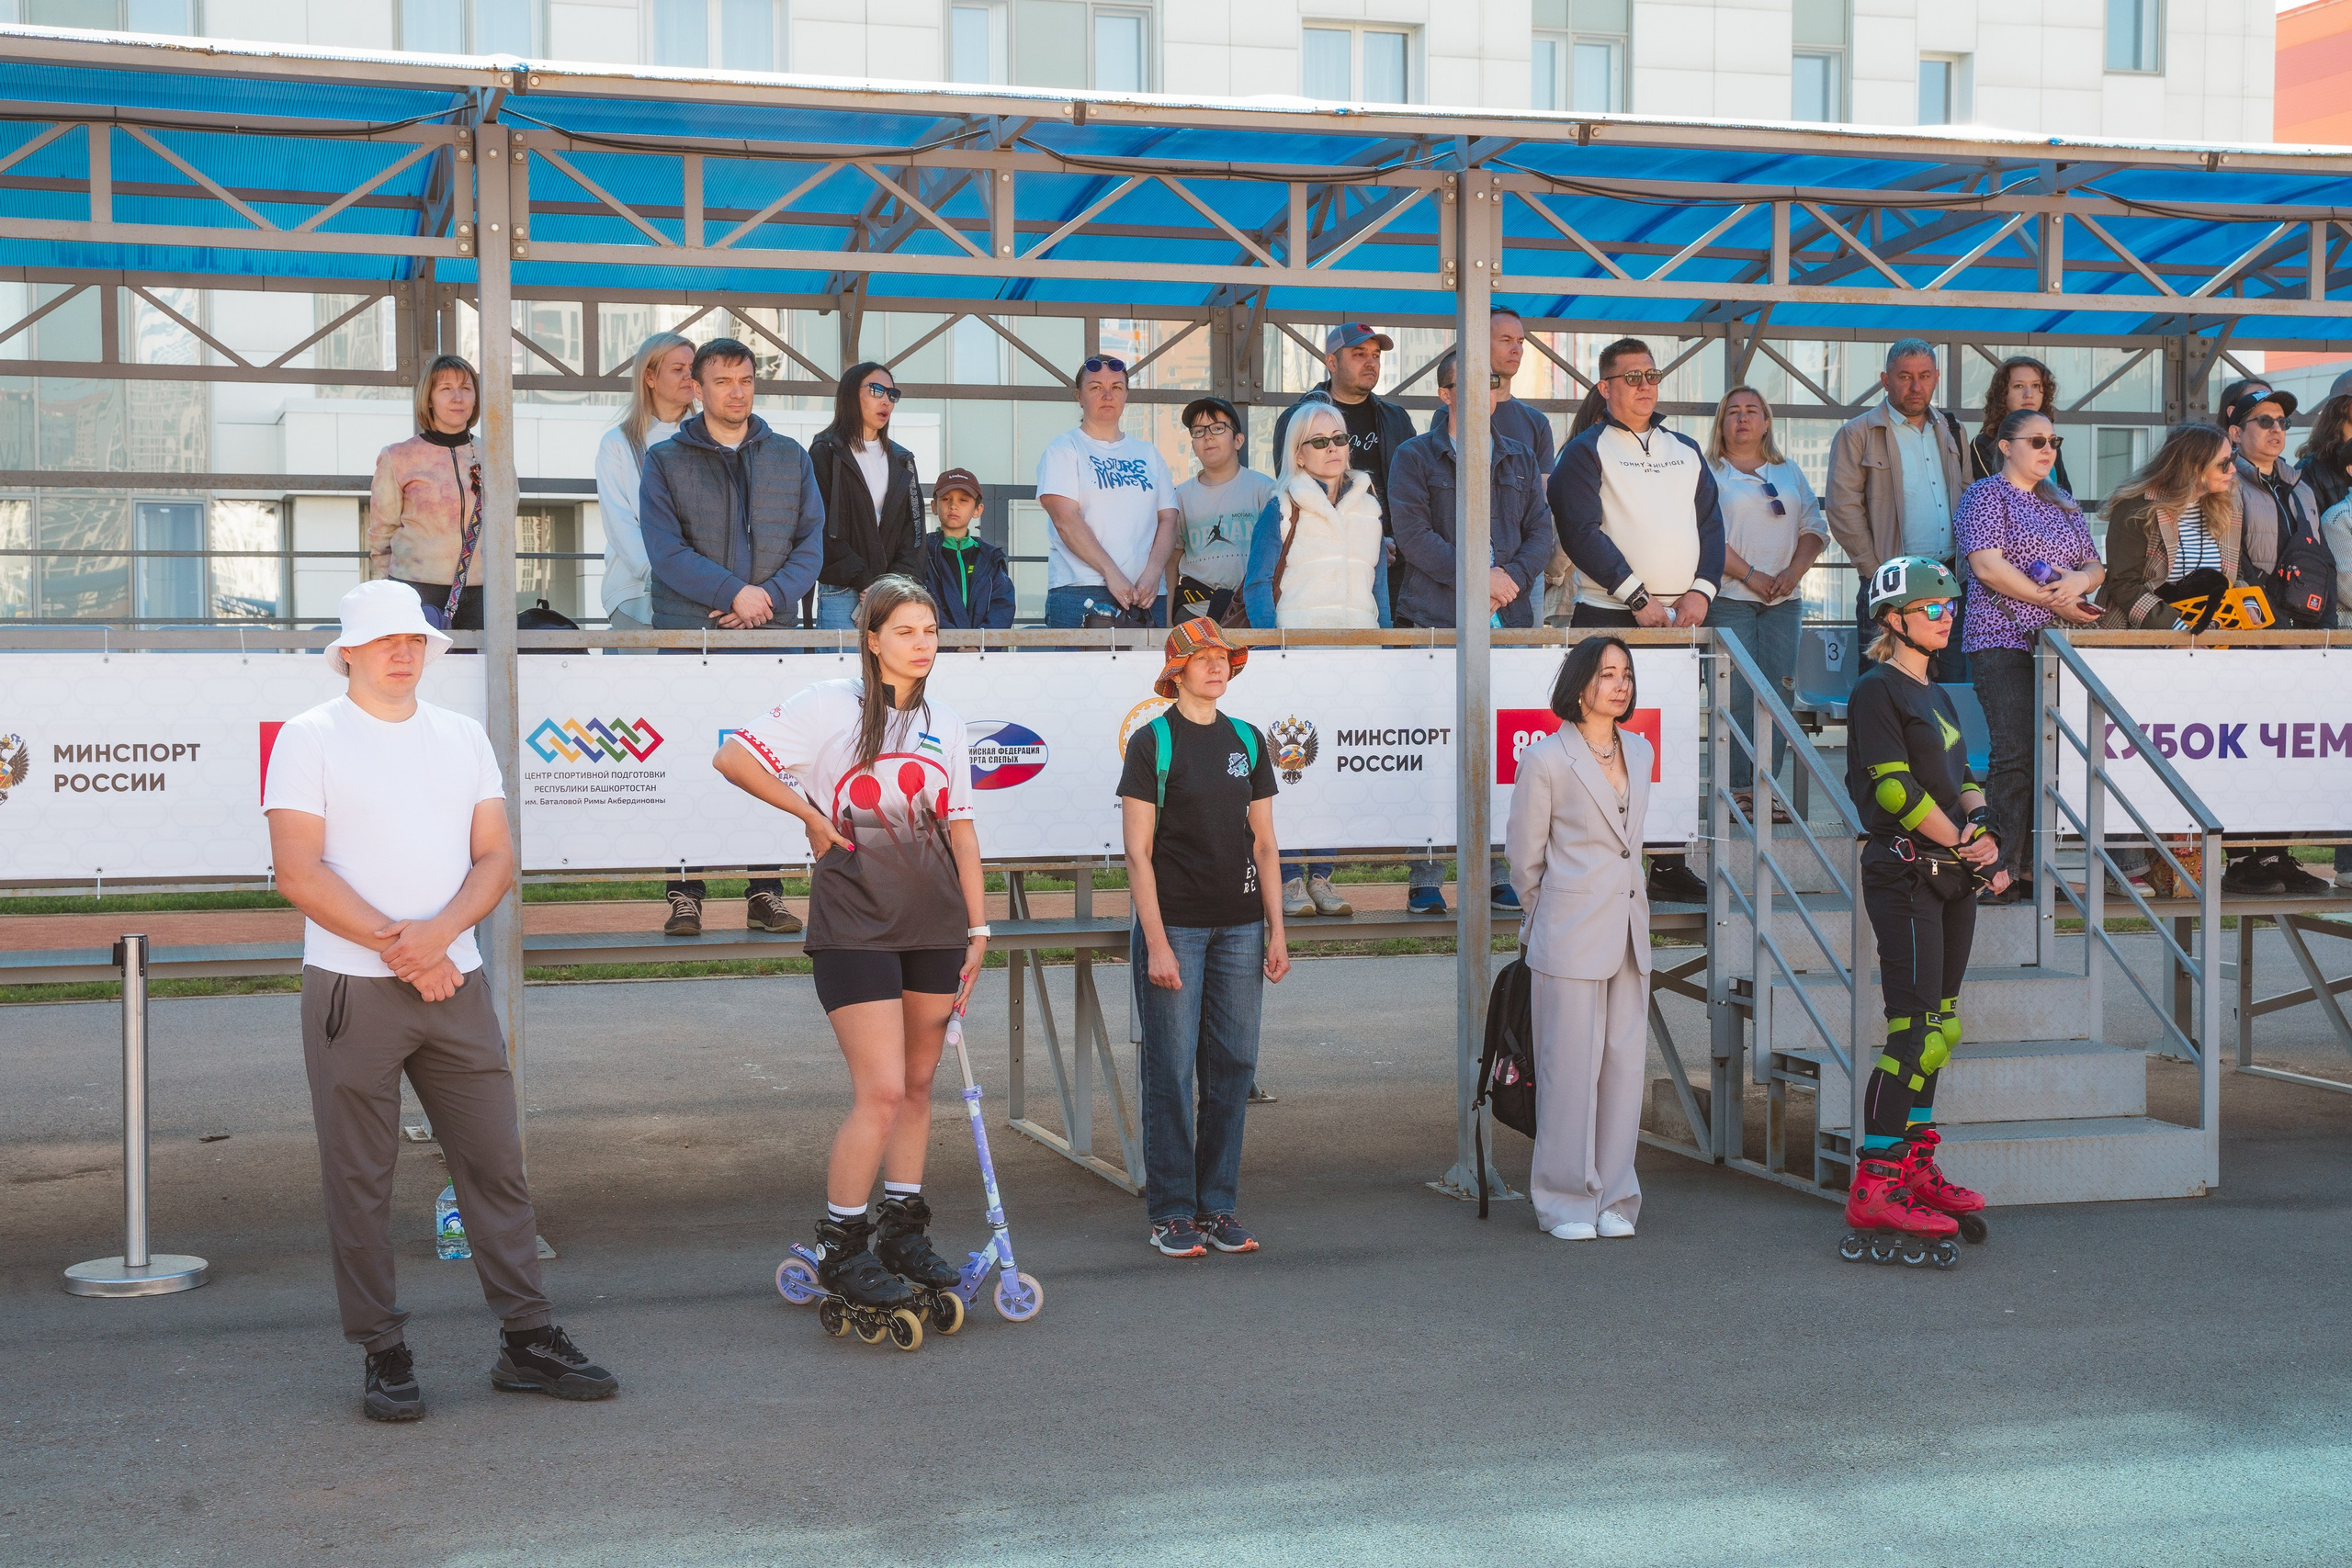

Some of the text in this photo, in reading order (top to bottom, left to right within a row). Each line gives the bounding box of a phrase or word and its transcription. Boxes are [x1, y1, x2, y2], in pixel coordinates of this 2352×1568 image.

[1089, 455, 1147, 473] FUTURE
[1653, 459, 1685, 468] HILFIGER
[1094, 468, 1154, 492] MAKER
[1871, 565, 1901, 600] 10
[1828, 642, 1839, 661] 3
[1337, 728, 1452, 747] МИНСПОРТ
[53, 742, 201, 763] МИНСПОРТ
[968, 746, 1040, 756] ИЙСКАЯ ФЕДЕРАЦИЯ
[989, 755, 1019, 763] СЛЕПЫХ
[1337, 754, 1423, 773] РОССИИ
[53, 773, 165, 793] РОССИИ
[525, 770, 666, 780] ЦЕНТР СПОРТИВНОЙ ПОДГОТОВКИ
[534, 784, 657, 793] РЕСПУБЛИКИ БАШКОРТОСТАН
[540, 796, 582, 806] Баталовой
[607, 796, 666, 806] Акбердиновны
